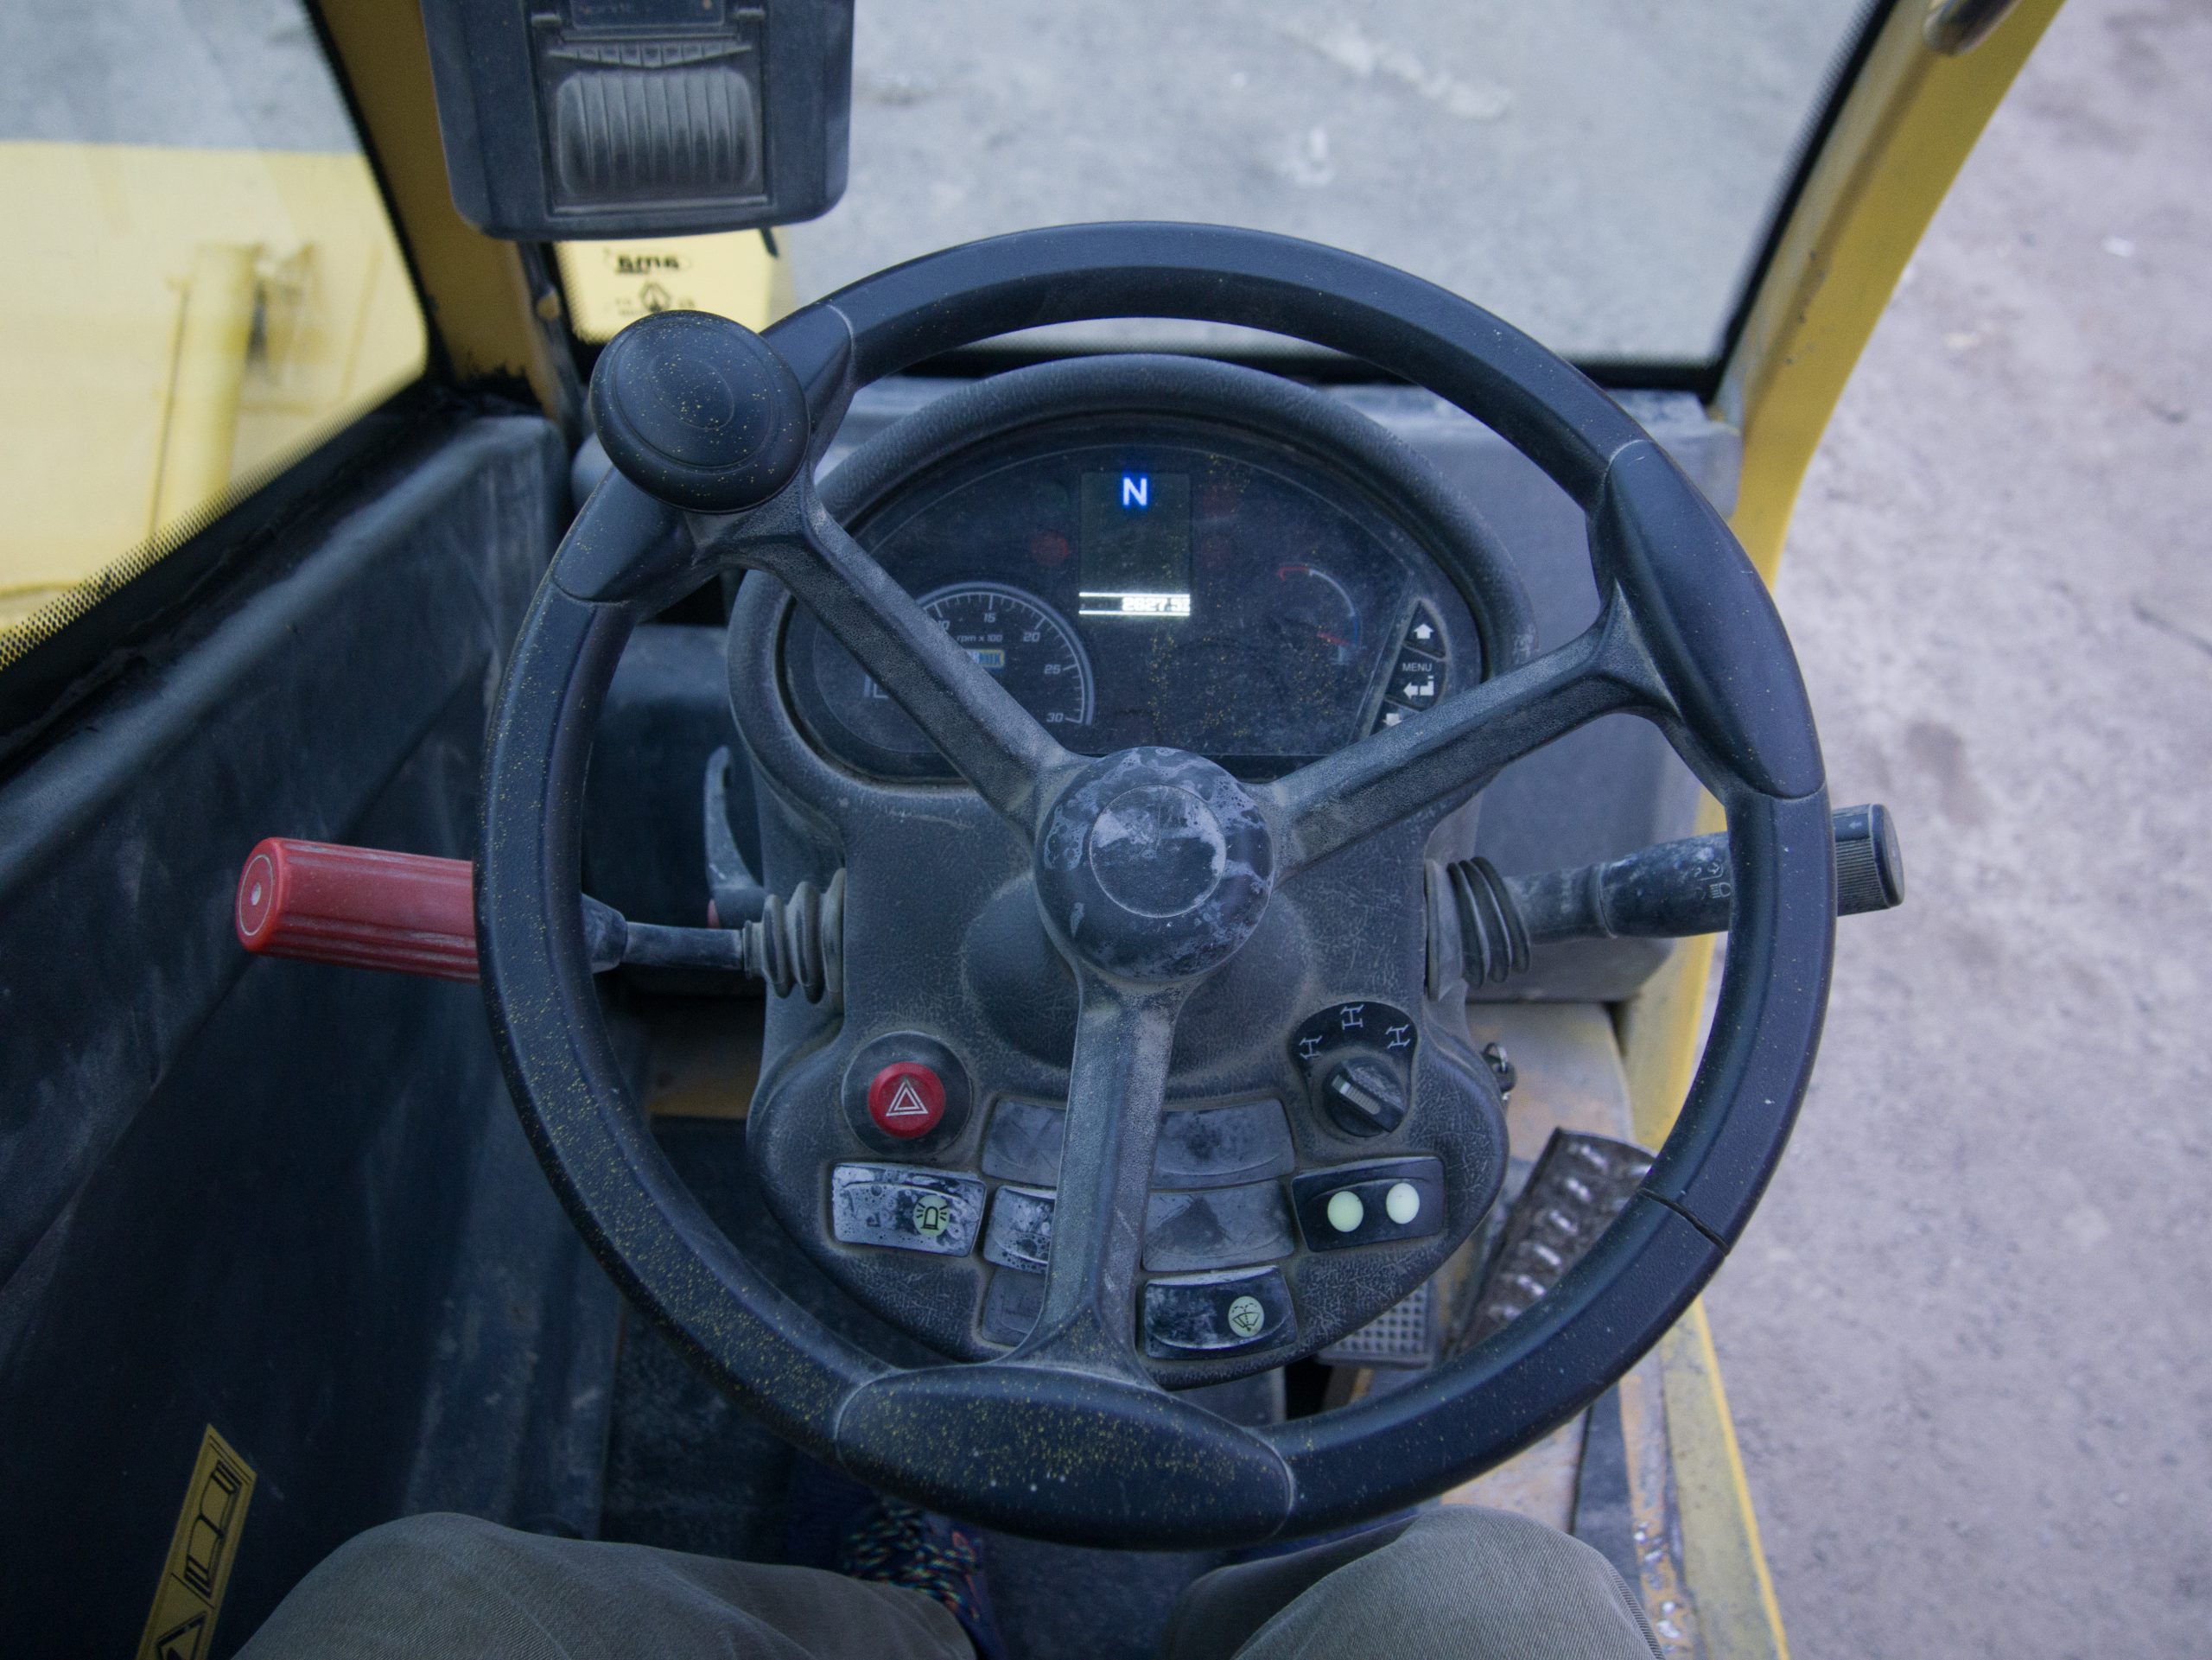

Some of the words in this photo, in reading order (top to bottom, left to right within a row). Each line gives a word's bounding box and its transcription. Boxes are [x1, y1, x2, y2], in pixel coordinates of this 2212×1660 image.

[1123, 478, 1147, 506] N
[983, 613, 996, 623] 15
[957, 634, 976, 643] rpm
[1022, 632, 1040, 642] 20
[1044, 665, 1061, 675] 25
[1402, 662, 1433, 672] MENU
[1046, 712, 1064, 723] 30
